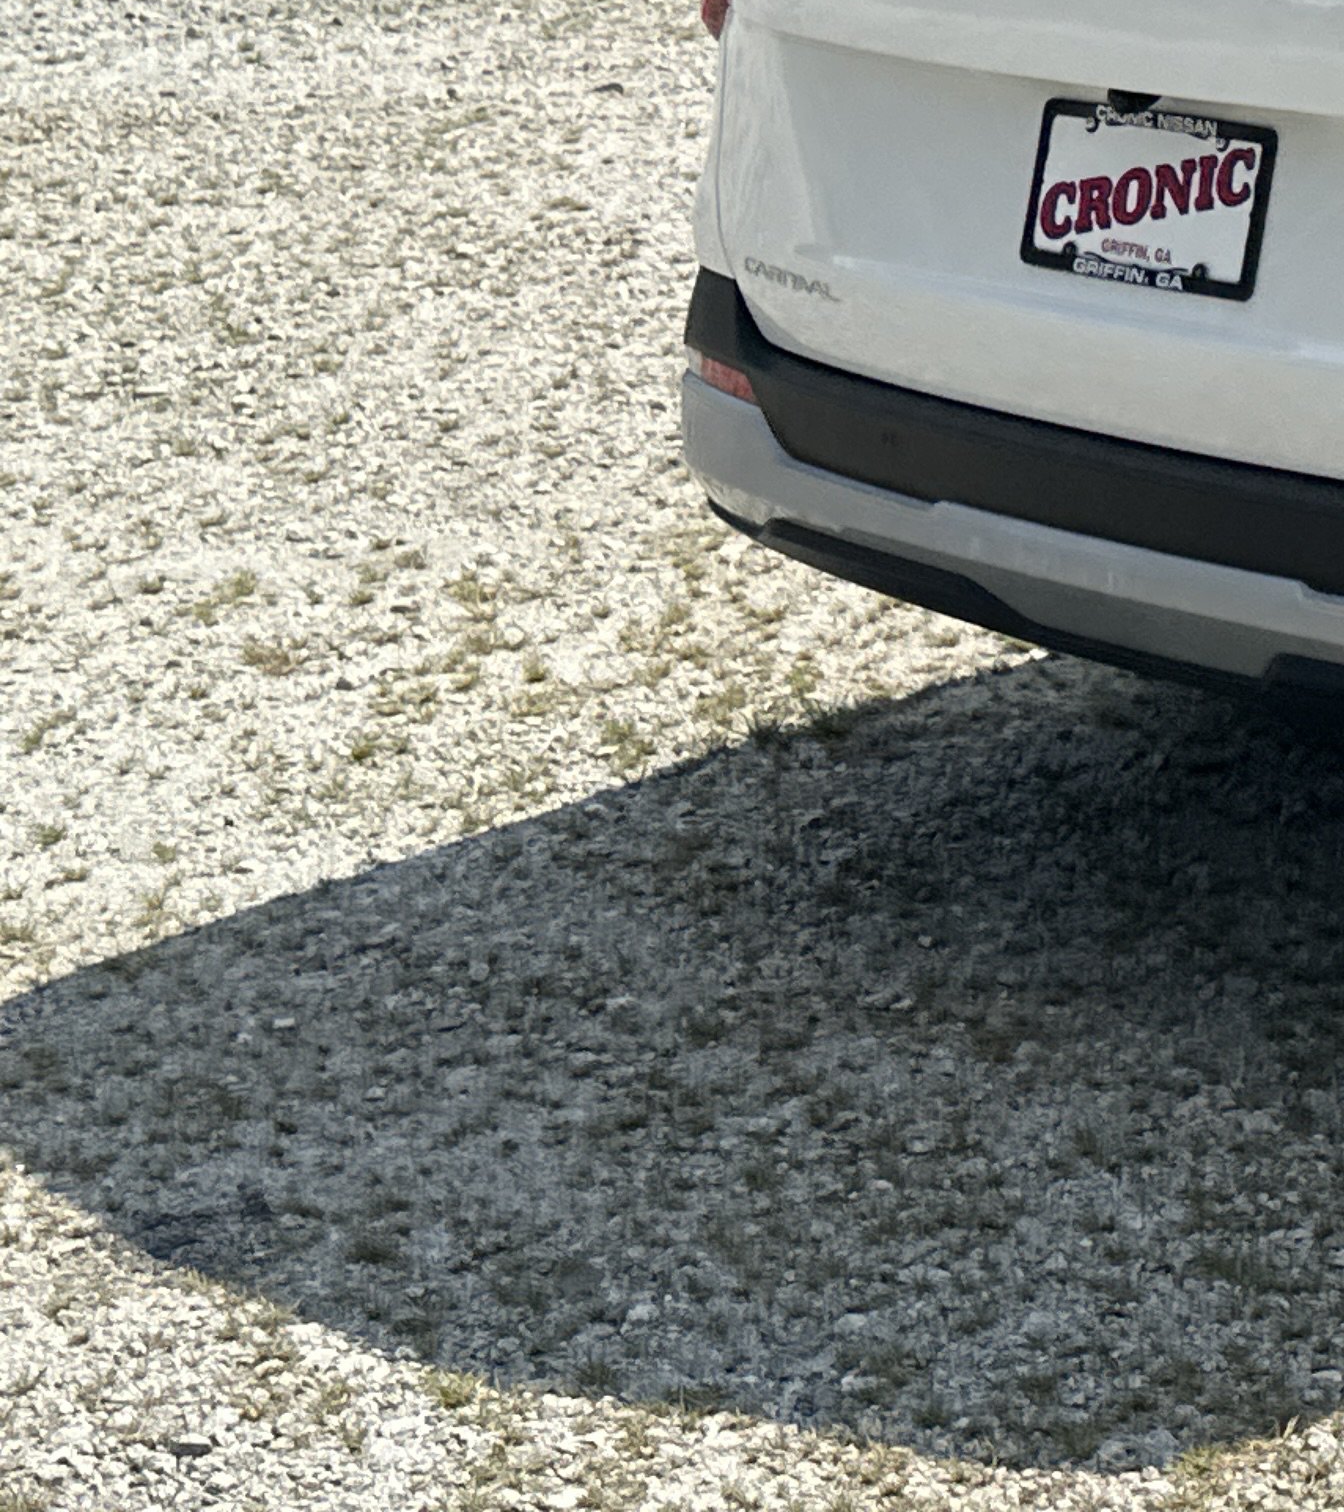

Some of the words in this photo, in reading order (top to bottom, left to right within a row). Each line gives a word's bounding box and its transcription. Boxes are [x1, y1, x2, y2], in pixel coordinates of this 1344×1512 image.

[1157, 111, 1218, 138] NISSAN
[1040, 147, 1256, 240] CRONIC
[1154, 248, 1173, 265] GA
[744, 256, 842, 303] CARNIVAL
[1155, 272, 1183, 290] GA
